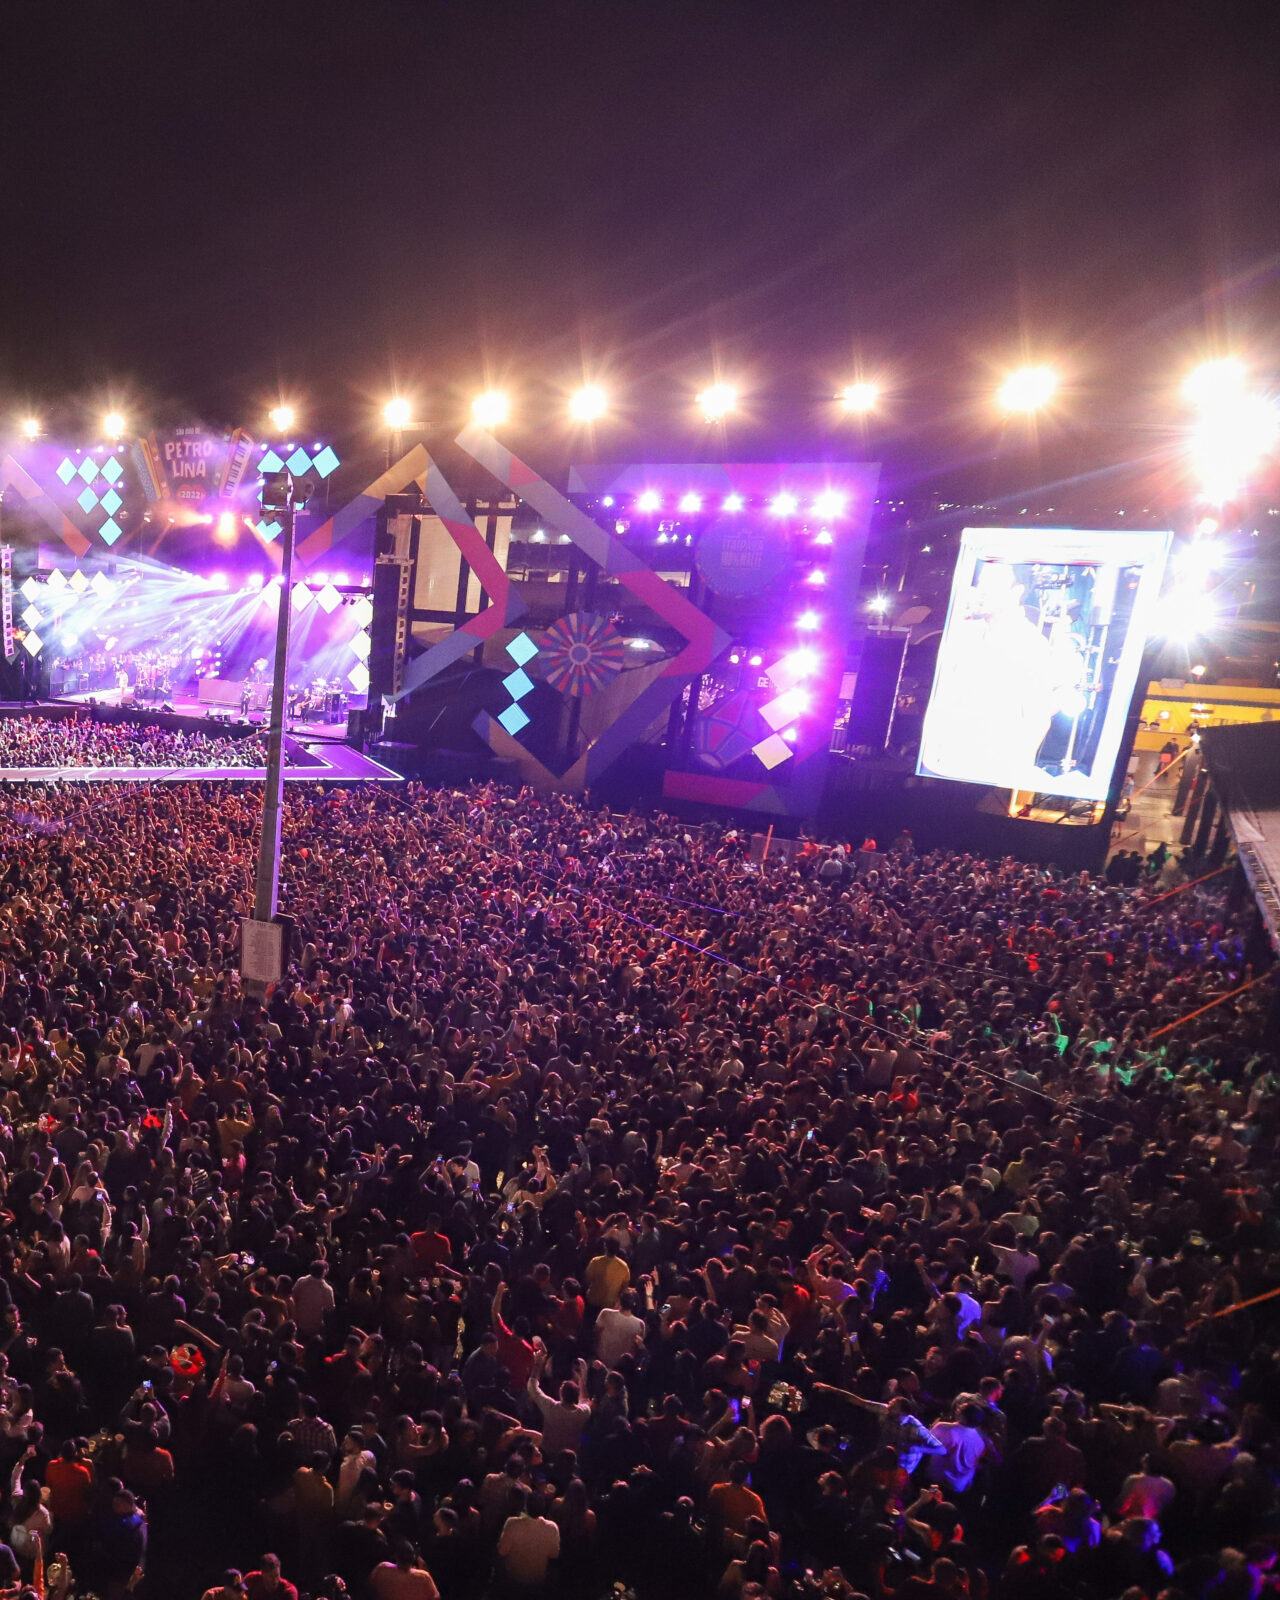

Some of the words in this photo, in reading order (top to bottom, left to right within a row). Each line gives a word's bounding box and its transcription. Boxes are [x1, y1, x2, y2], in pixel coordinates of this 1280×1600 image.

[165, 440, 213, 460] PETRO
[172, 460, 206, 478] LINA
[181, 490, 201, 499] 2022
